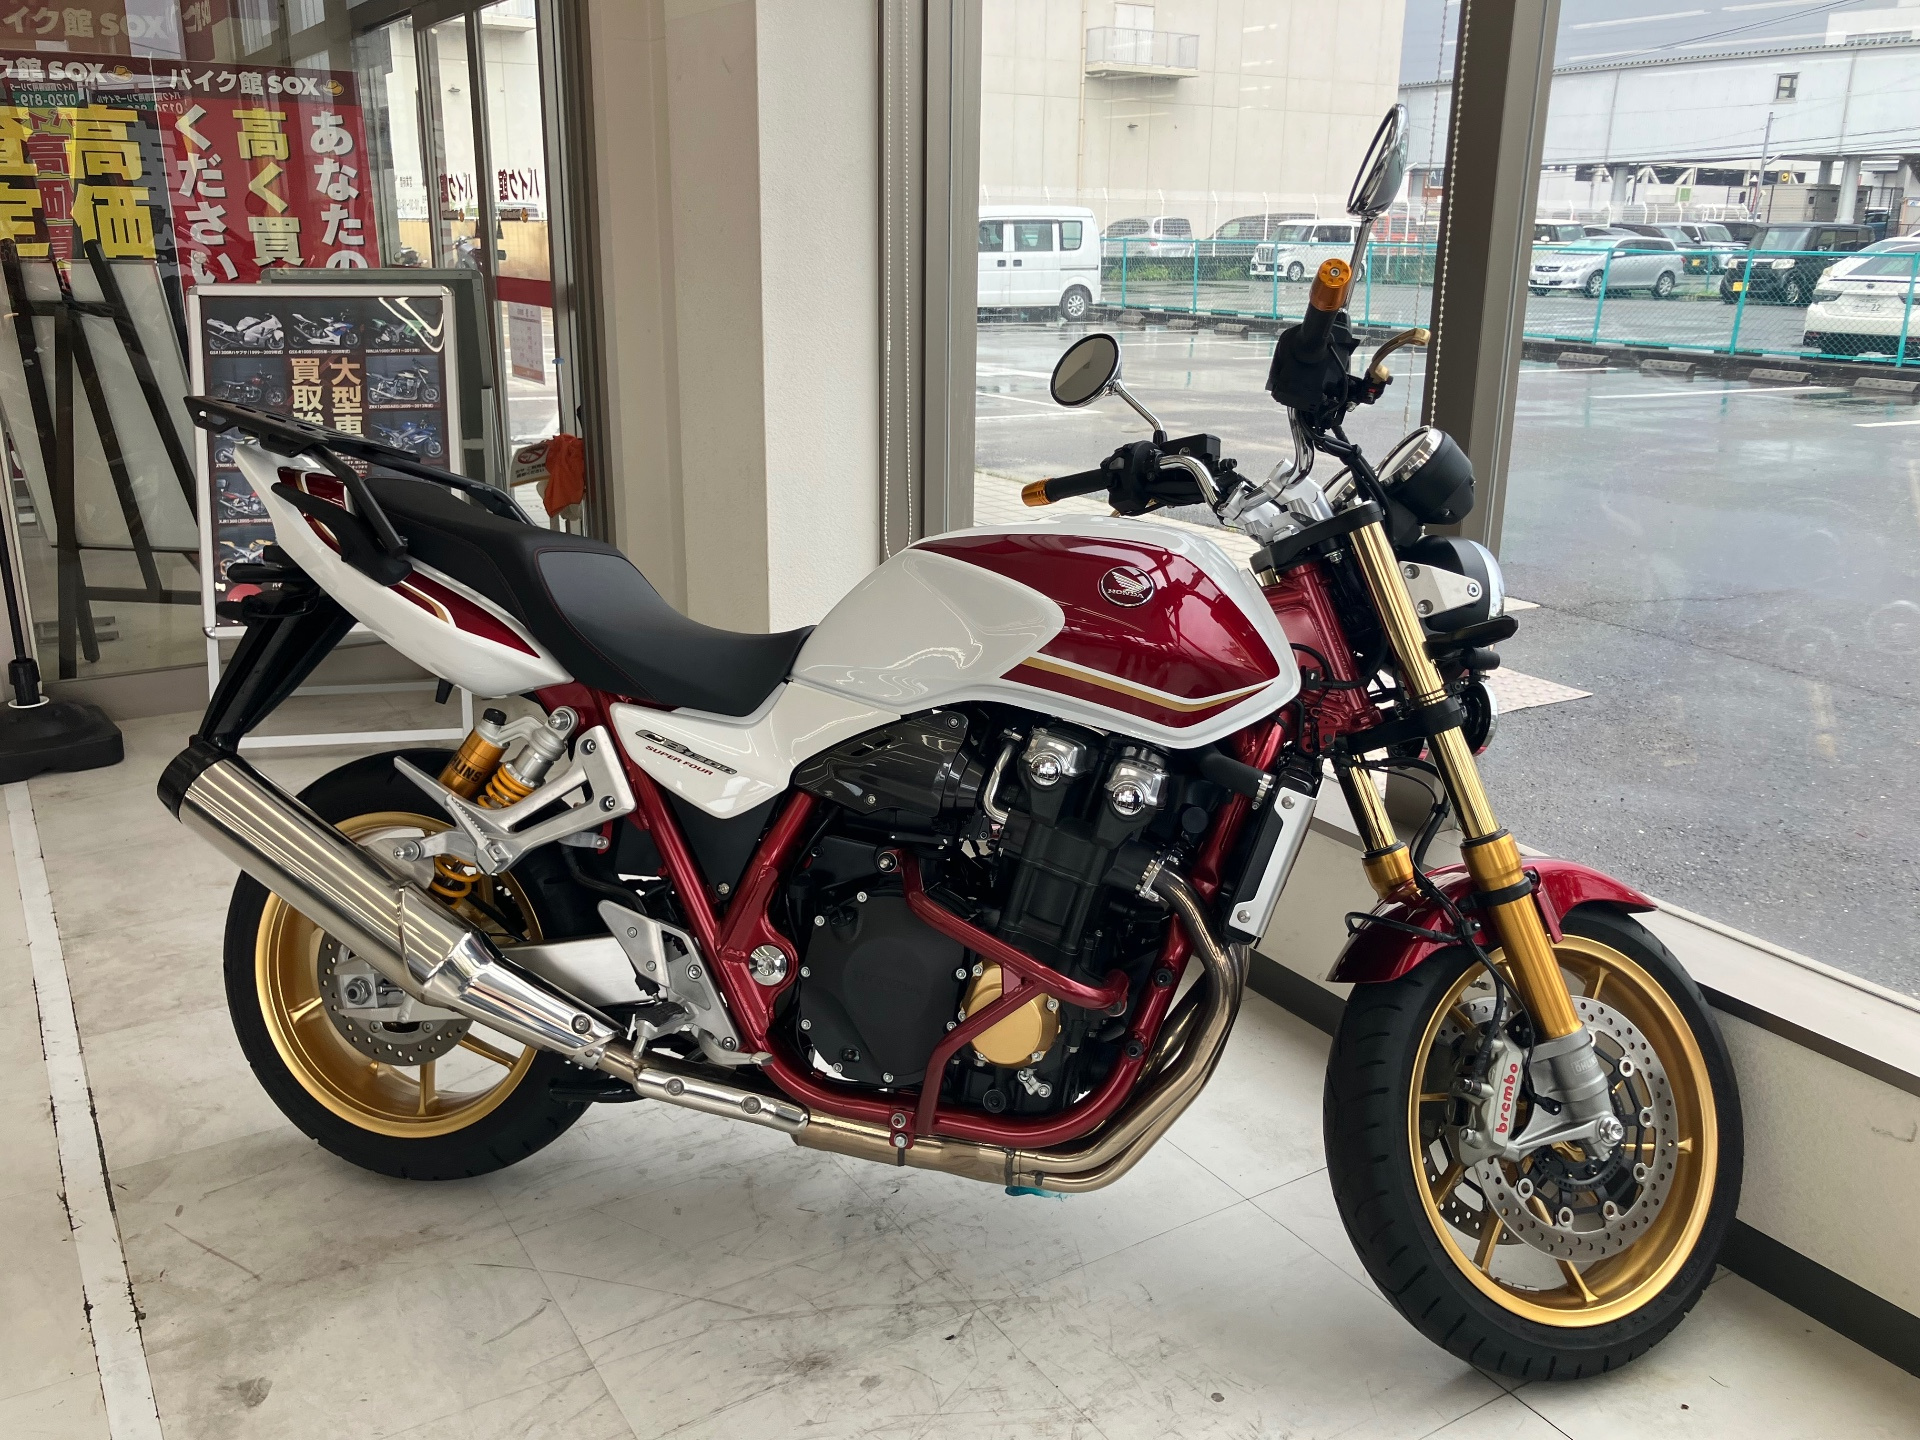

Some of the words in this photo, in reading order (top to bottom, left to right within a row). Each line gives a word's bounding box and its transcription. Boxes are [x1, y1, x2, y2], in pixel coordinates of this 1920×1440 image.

[48, 61, 107, 84] SOX
[170, 68, 264, 96] バイク館
[268, 75, 321, 97] SOX
[70, 104, 156, 259] 高価
[174, 103, 239, 284] ください
[232, 107, 304, 266] 高く買
[330, 357, 364, 437] 大型車
[1107, 588, 1145, 599] HONDA
[645, 745, 683, 763] SUPER
[683, 761, 714, 776] FOUR
[1495, 1063, 1518, 1133] brembo
